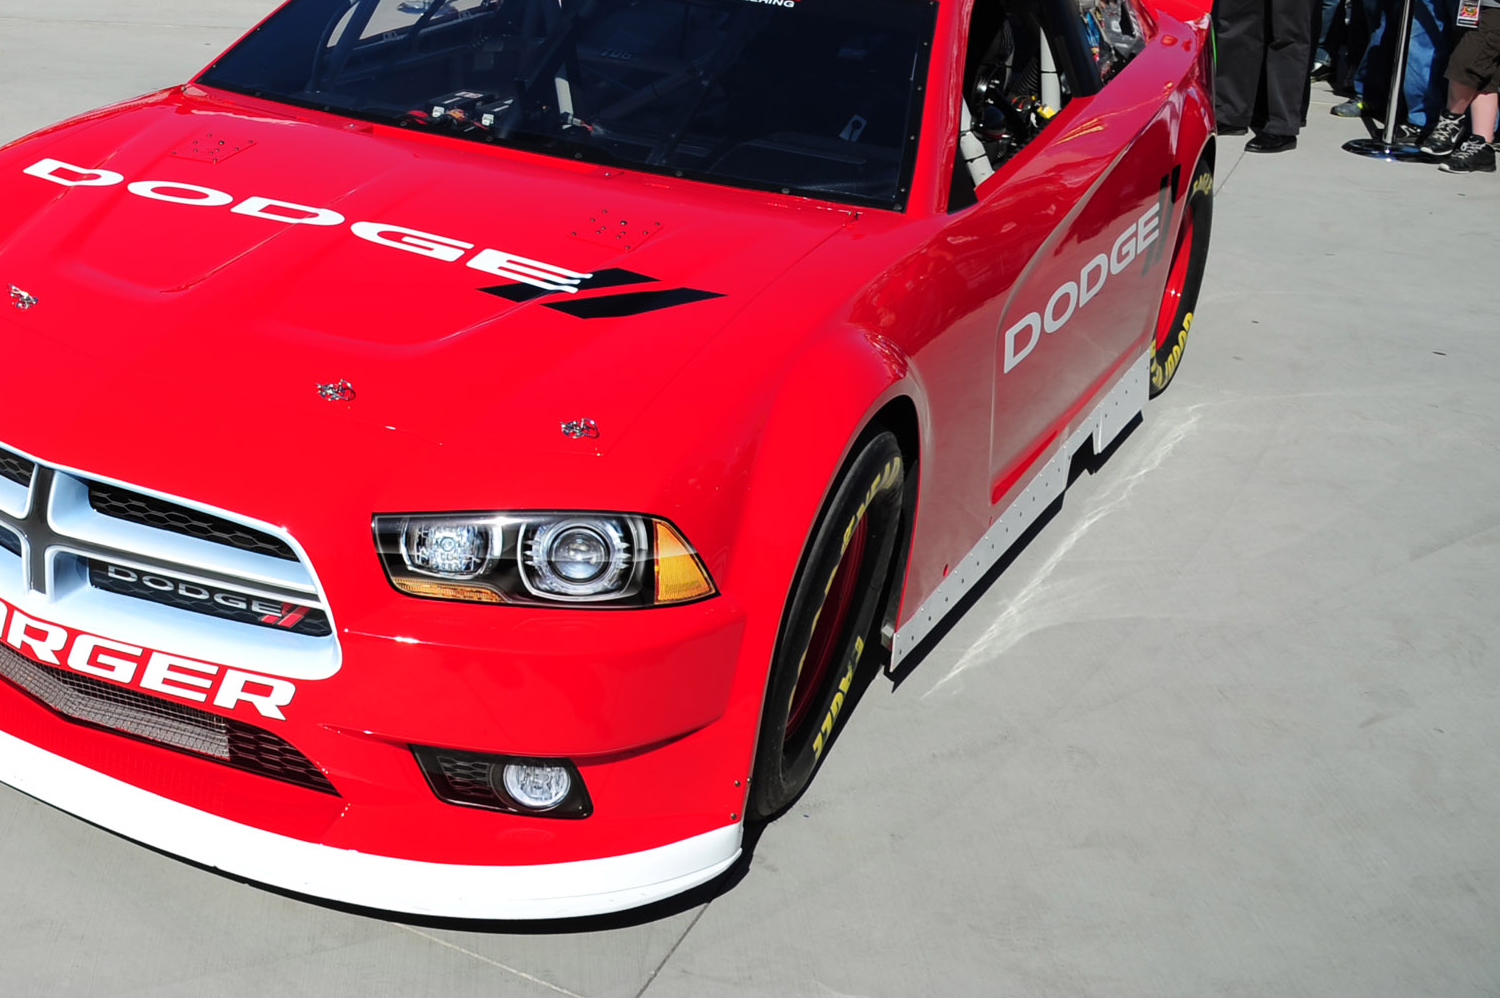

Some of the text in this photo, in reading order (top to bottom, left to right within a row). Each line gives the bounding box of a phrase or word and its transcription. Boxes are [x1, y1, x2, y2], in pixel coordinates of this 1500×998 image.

[23, 157, 593, 293] DODGE
[1003, 202, 1160, 375] DODGE
[107, 564, 283, 618] DODGE
